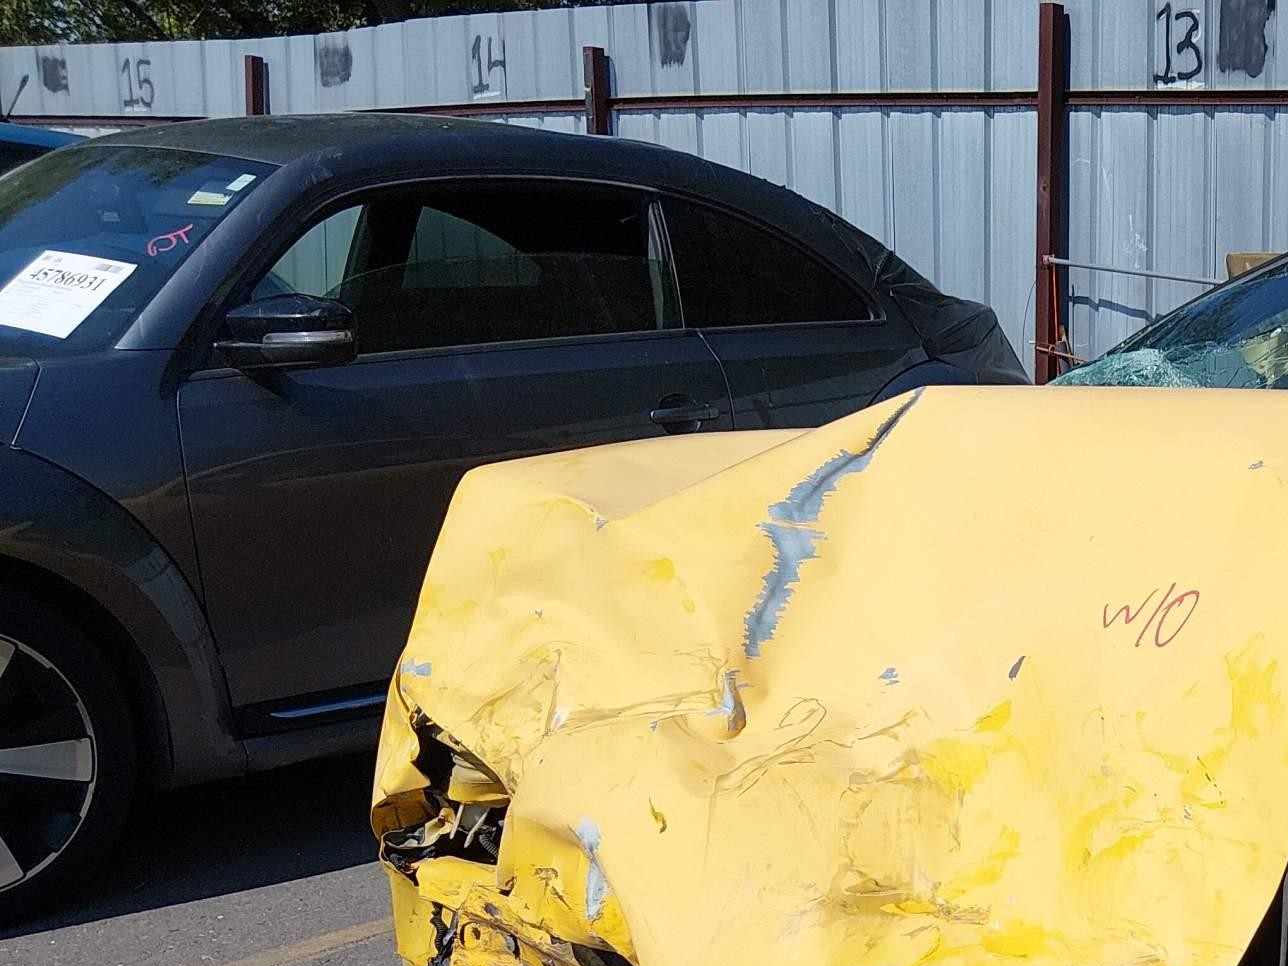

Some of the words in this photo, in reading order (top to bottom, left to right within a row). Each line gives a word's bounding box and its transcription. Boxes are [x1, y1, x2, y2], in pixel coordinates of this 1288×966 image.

[471, 34, 508, 101] 14
[1153, 2, 1203, 84] 13
[121, 58, 155, 107] 15
[30, 267, 107, 291] 45786931
